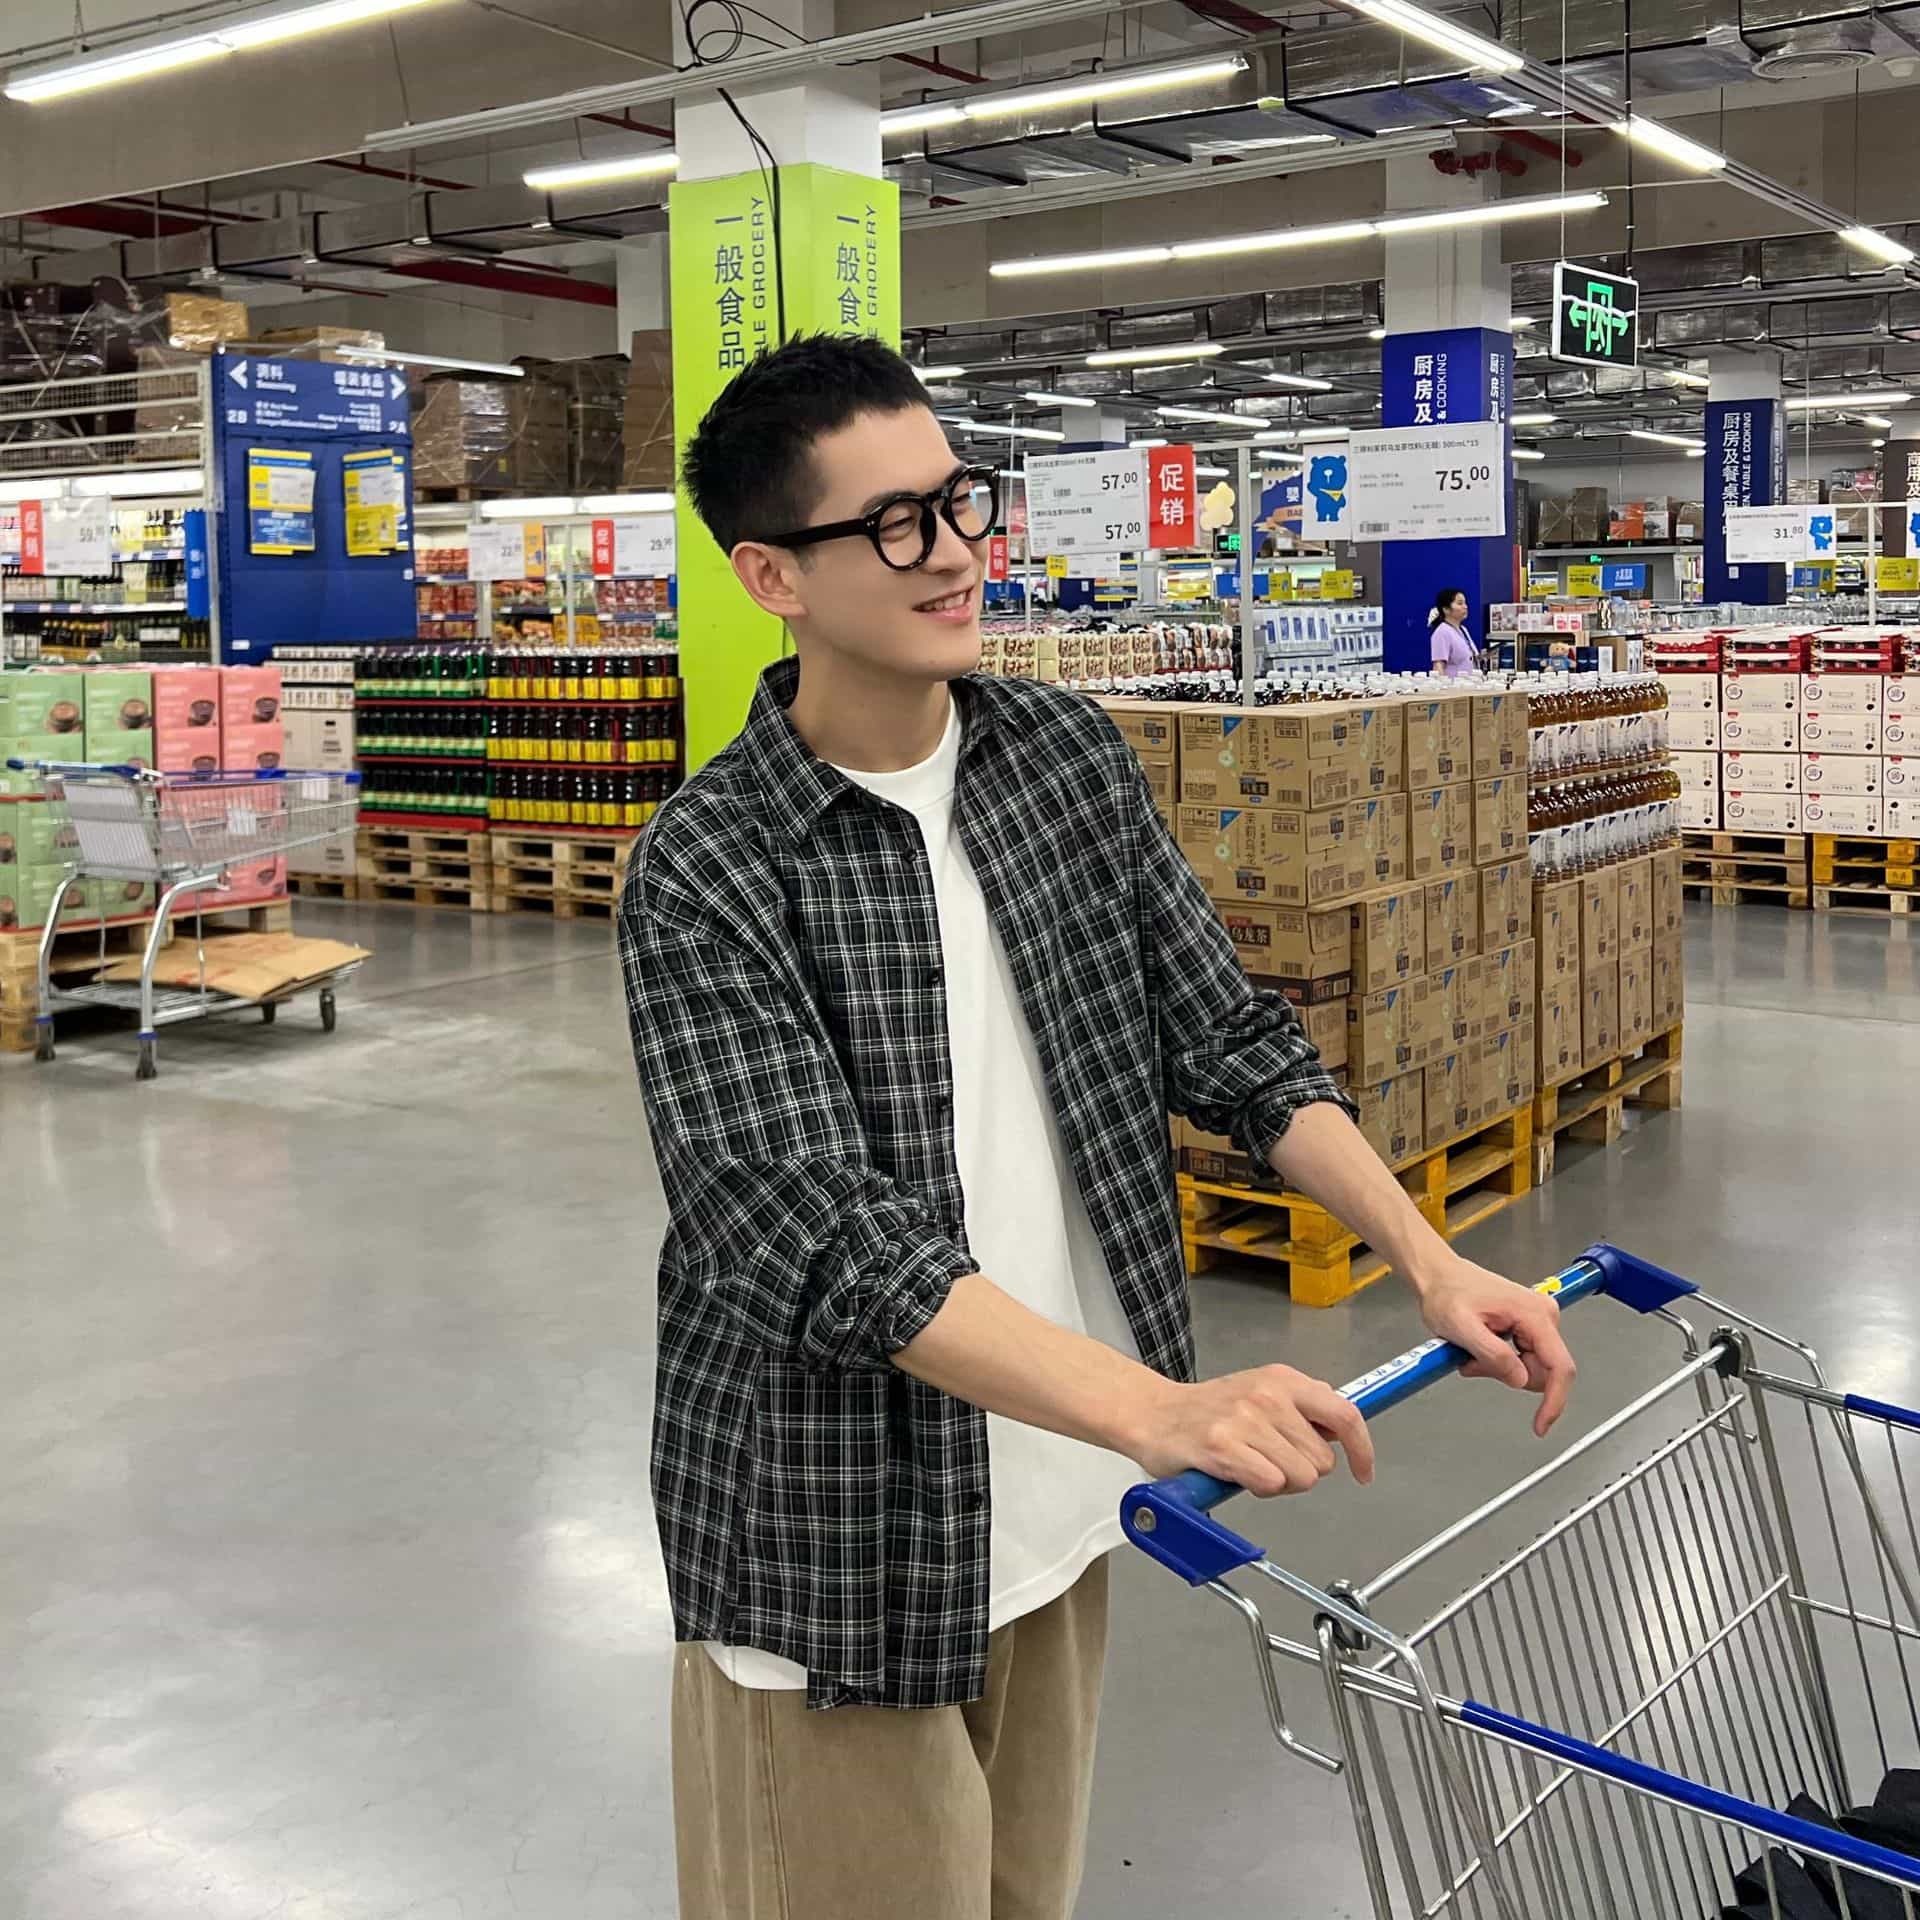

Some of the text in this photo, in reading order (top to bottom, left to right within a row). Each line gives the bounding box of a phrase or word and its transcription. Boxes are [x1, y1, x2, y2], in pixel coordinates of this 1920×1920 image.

[751, 197, 766, 309] GROCERY
[836, 215, 862, 337] 一般食
[865, 204, 878, 316] GROCERY
[714, 216, 745, 369] 一般食品
[1413, 355, 1434, 424] 厨房及
[1436, 353, 1447, 408] COOKING
[1101, 472, 1138, 491] 57.00
[1159, 463, 1185, 526] 促销
[1435, 466, 1490, 491] 75.00
[1105, 522, 1141, 540] 57.00
